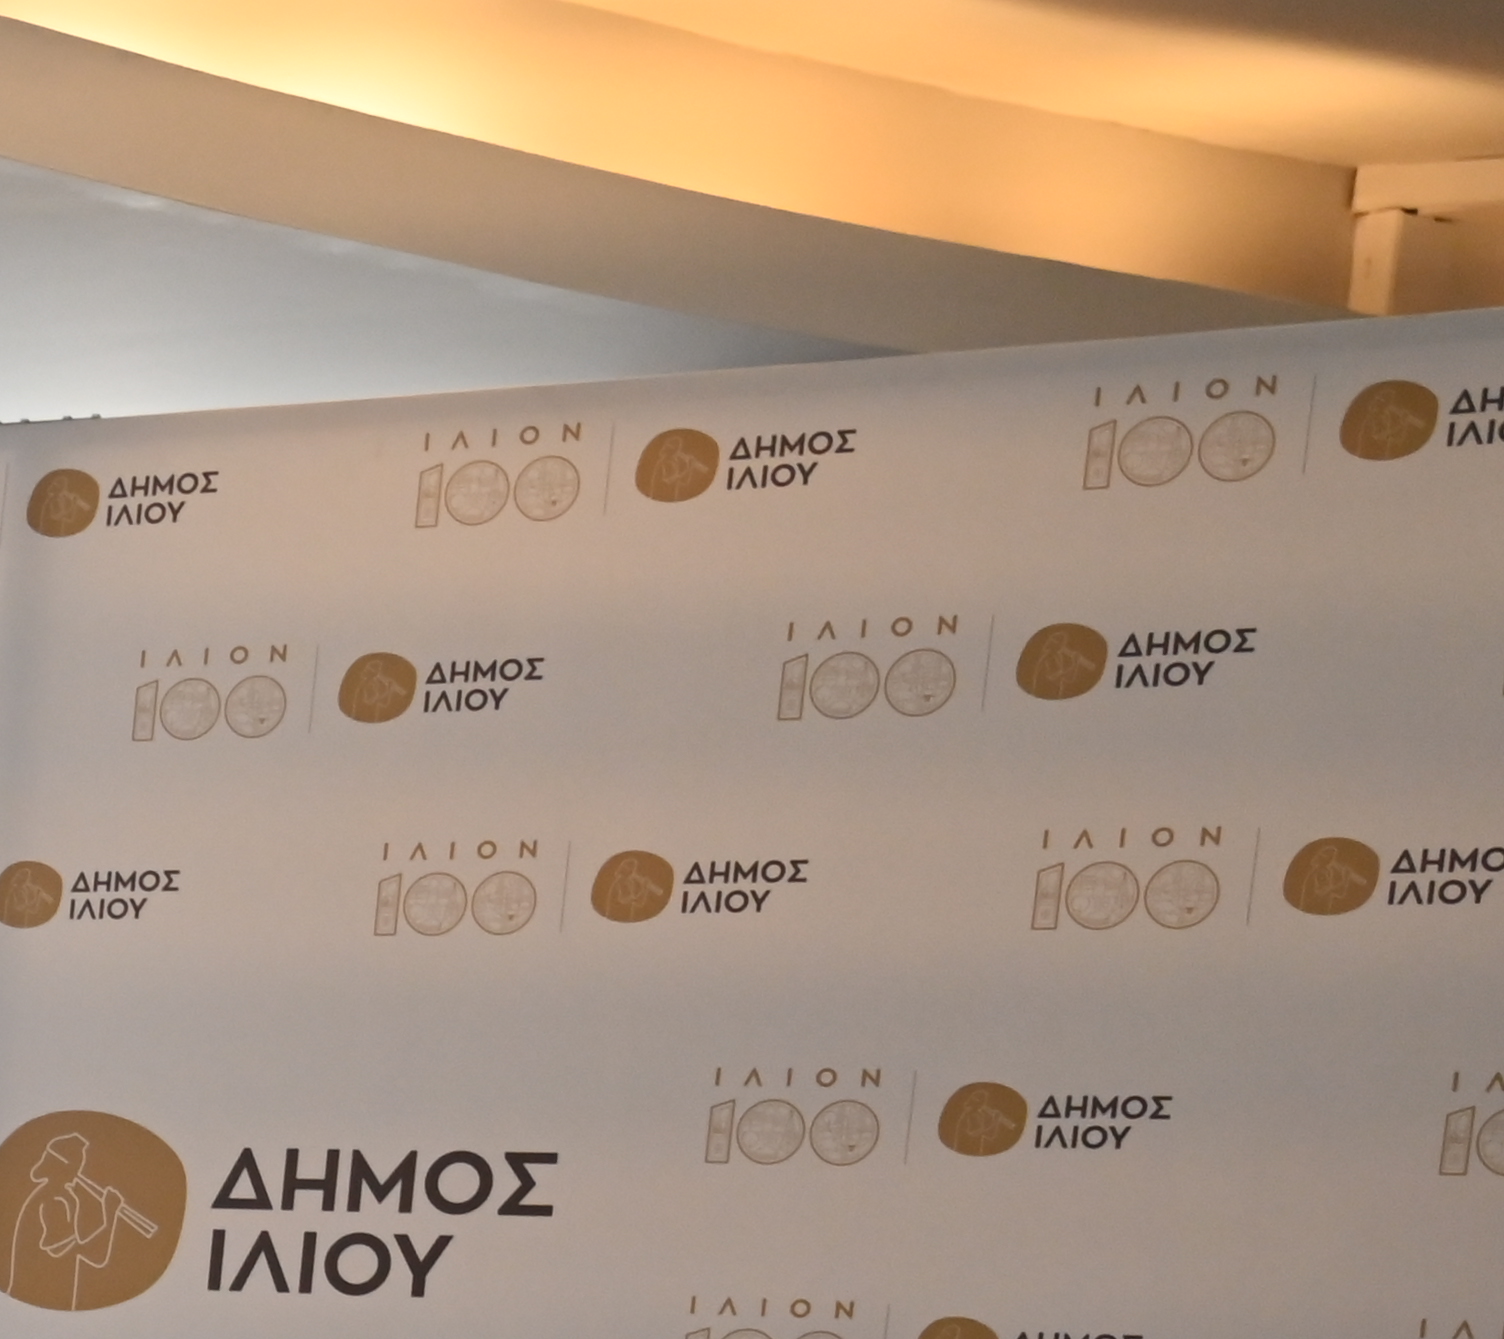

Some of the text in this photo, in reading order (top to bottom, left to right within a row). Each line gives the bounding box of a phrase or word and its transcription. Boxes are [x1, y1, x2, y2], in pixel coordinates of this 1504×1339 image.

[1094, 374, 1278, 408] ΙΛΙΟΝ
[424, 422, 582, 452] ΙΛΙΟΝ
[729, 429, 857, 461] ΔΗΜΟΣ
[108, 471, 219, 499] ΔΗΜΟΣ
[727, 462, 818, 490] ΙΛΙΟΥ
[106, 501, 185, 526] ΙΛΙΟΥ
[787, 614, 958, 642] ΙΛΙΟΝ
[140, 644, 288, 668] ΙΛΙΟΝ
[1118, 627, 1257, 658] ΔΗΜΟΣ
[425, 657, 545, 685] ΔΗΜΟΣ
[1115, 661, 1215, 689] ΙΛΙΟΥ
[423, 688, 509, 713] ΙΛΙΟΥ
[383, 840, 538, 861] ΙΛΙΟΝ
[1042, 825, 1222, 850] ΙΛΙΟΝ
[683, 859, 809, 884] ΔΗΜΟΣ
[1390, 847, 1504, 875] ΔΗΜΟ
[71, 870, 180, 893] ΔΗΜΟΣ
[1387, 879, 1493, 905] ΙΛΙΟΥ
[69, 898, 147, 920] ΙΛΙΟΥ
[681, 884, 772, 914] ΙΛΙΟΥ
[715, 1067, 882, 1088] ΙΛΙΟΝ
[1037, 1095, 1173, 1120] ΔΗΜΟΣ
[1035, 1125, 1131, 1150] ΙΛΙΟΥ
[211, 1147, 559, 1217] ΔΗΜΟΣ
[208, 1229, 454, 1298] ΙΛΙΟΥ
[690, 1295, 855, 1320] ΙΛΙΟΝ
